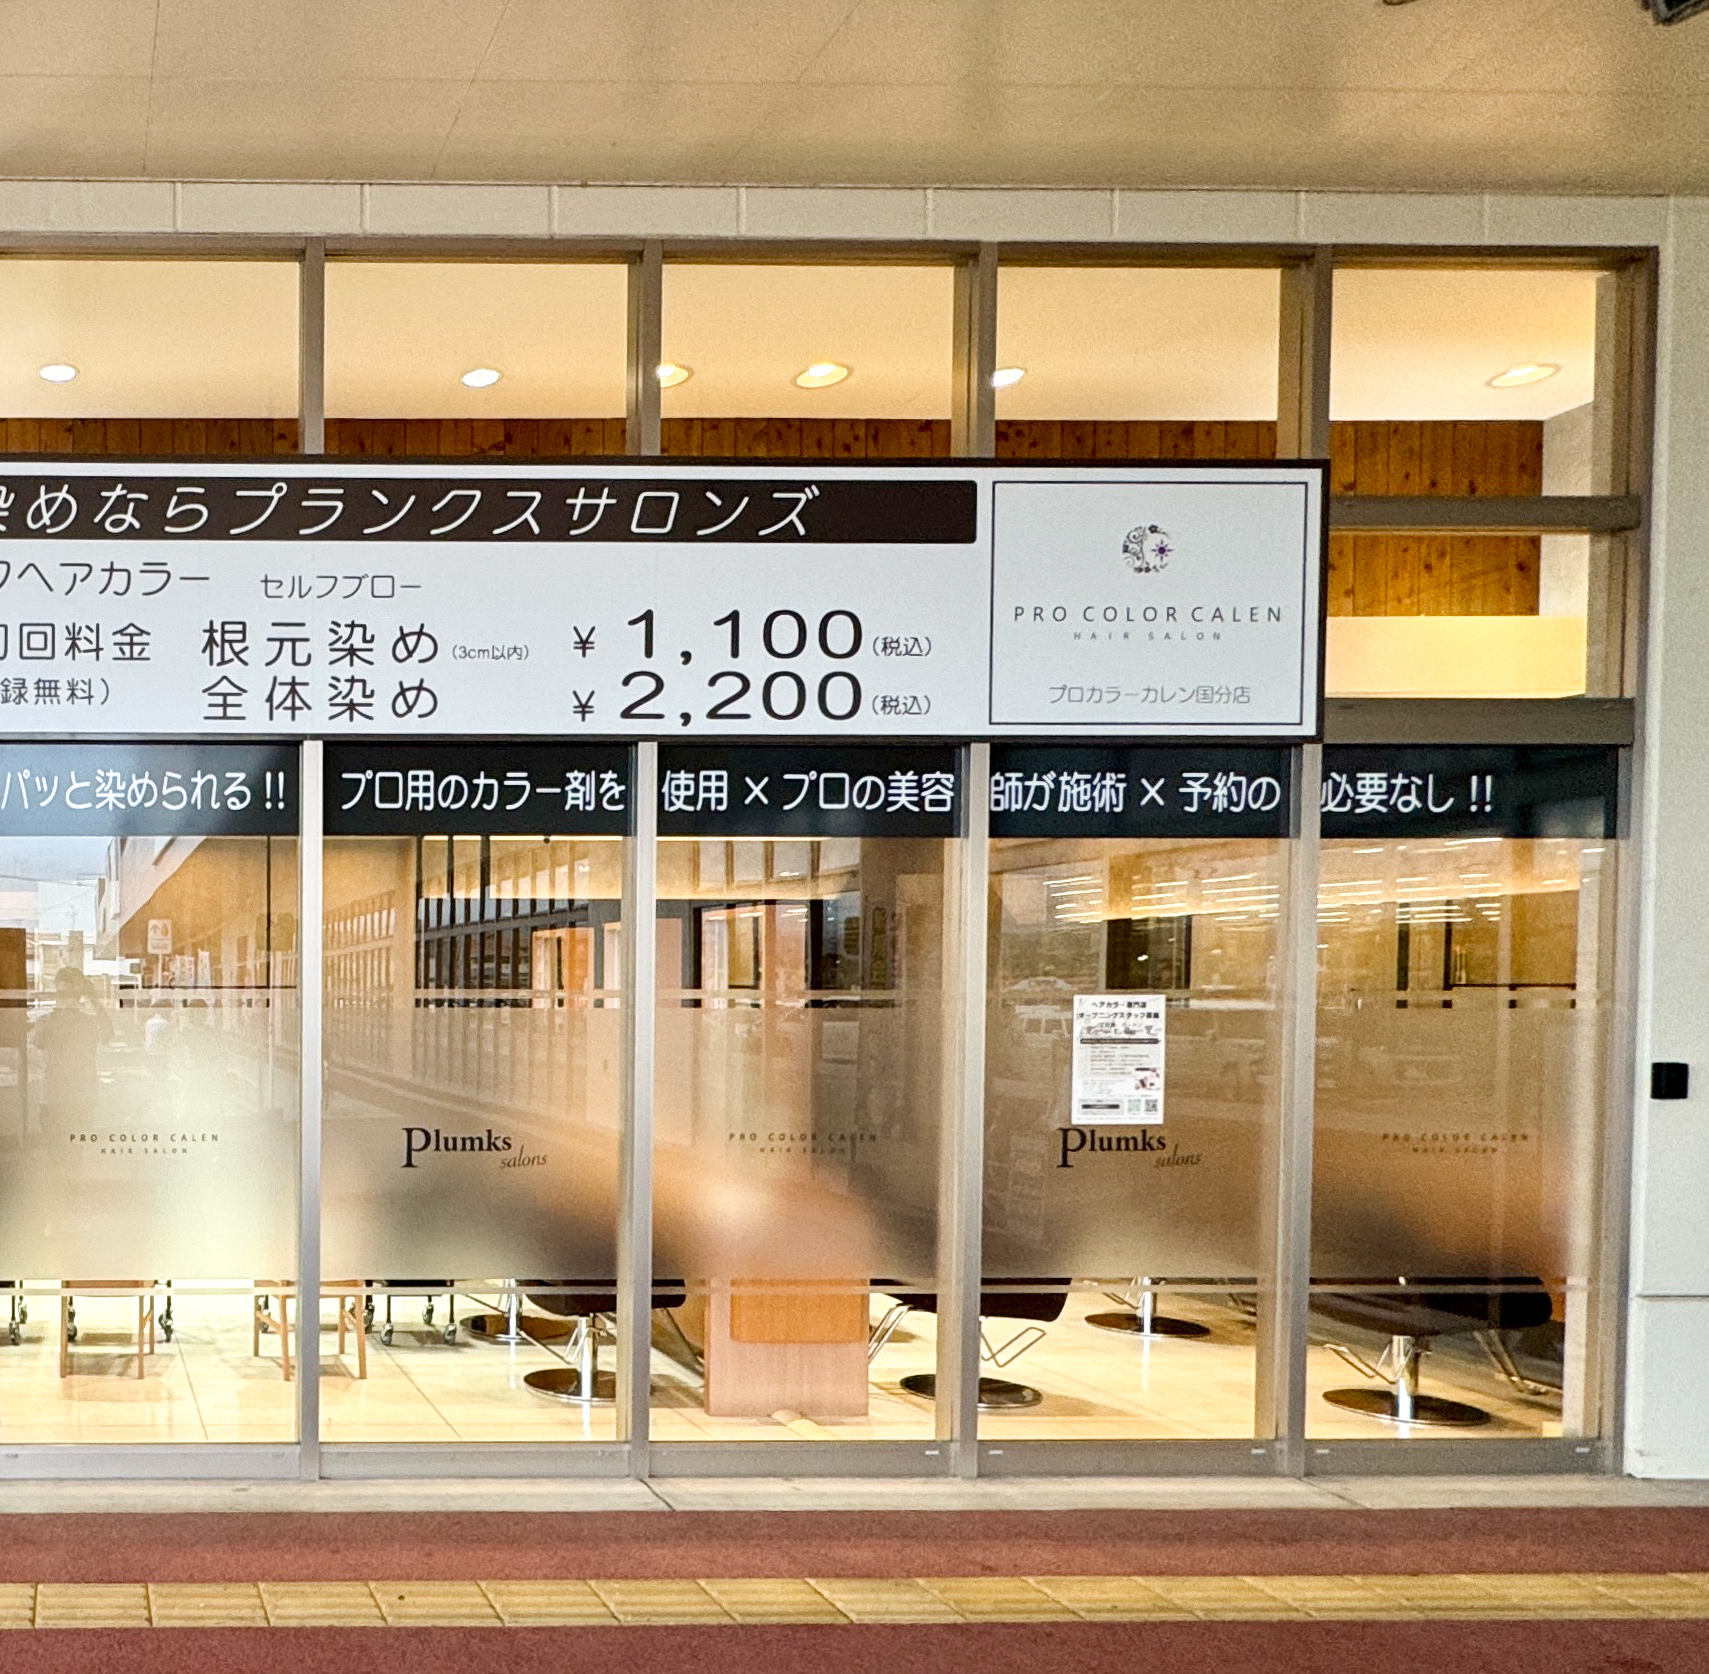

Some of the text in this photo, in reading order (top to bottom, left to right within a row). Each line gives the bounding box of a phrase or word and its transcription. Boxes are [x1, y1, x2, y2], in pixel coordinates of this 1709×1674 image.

[260, 573, 423, 600] セルフブロー
[1013, 605, 1282, 623] PRO COLOR CALEN
[202, 619, 440, 668] 根元染め
[627, 609, 863, 665] 1,100
[1073, 631, 1222, 642] HAIR SALON
[202, 674, 440, 723] 全体染め
[619, 671, 863, 728] 2,200
[1049, 684, 1251, 704] プロカラーカレン国分店
[70, 1134, 220, 1142] PRO COLOR CALEN
[401, 1127, 512, 1169] Plumks
[729, 1133, 758, 1142] PRO
[768, 1133, 818, 1142] COLOR
[1056, 1127, 1167, 1168] Plumks
[500, 1144, 548, 1169] salons
[1153, 1143, 1202, 1169] salons
